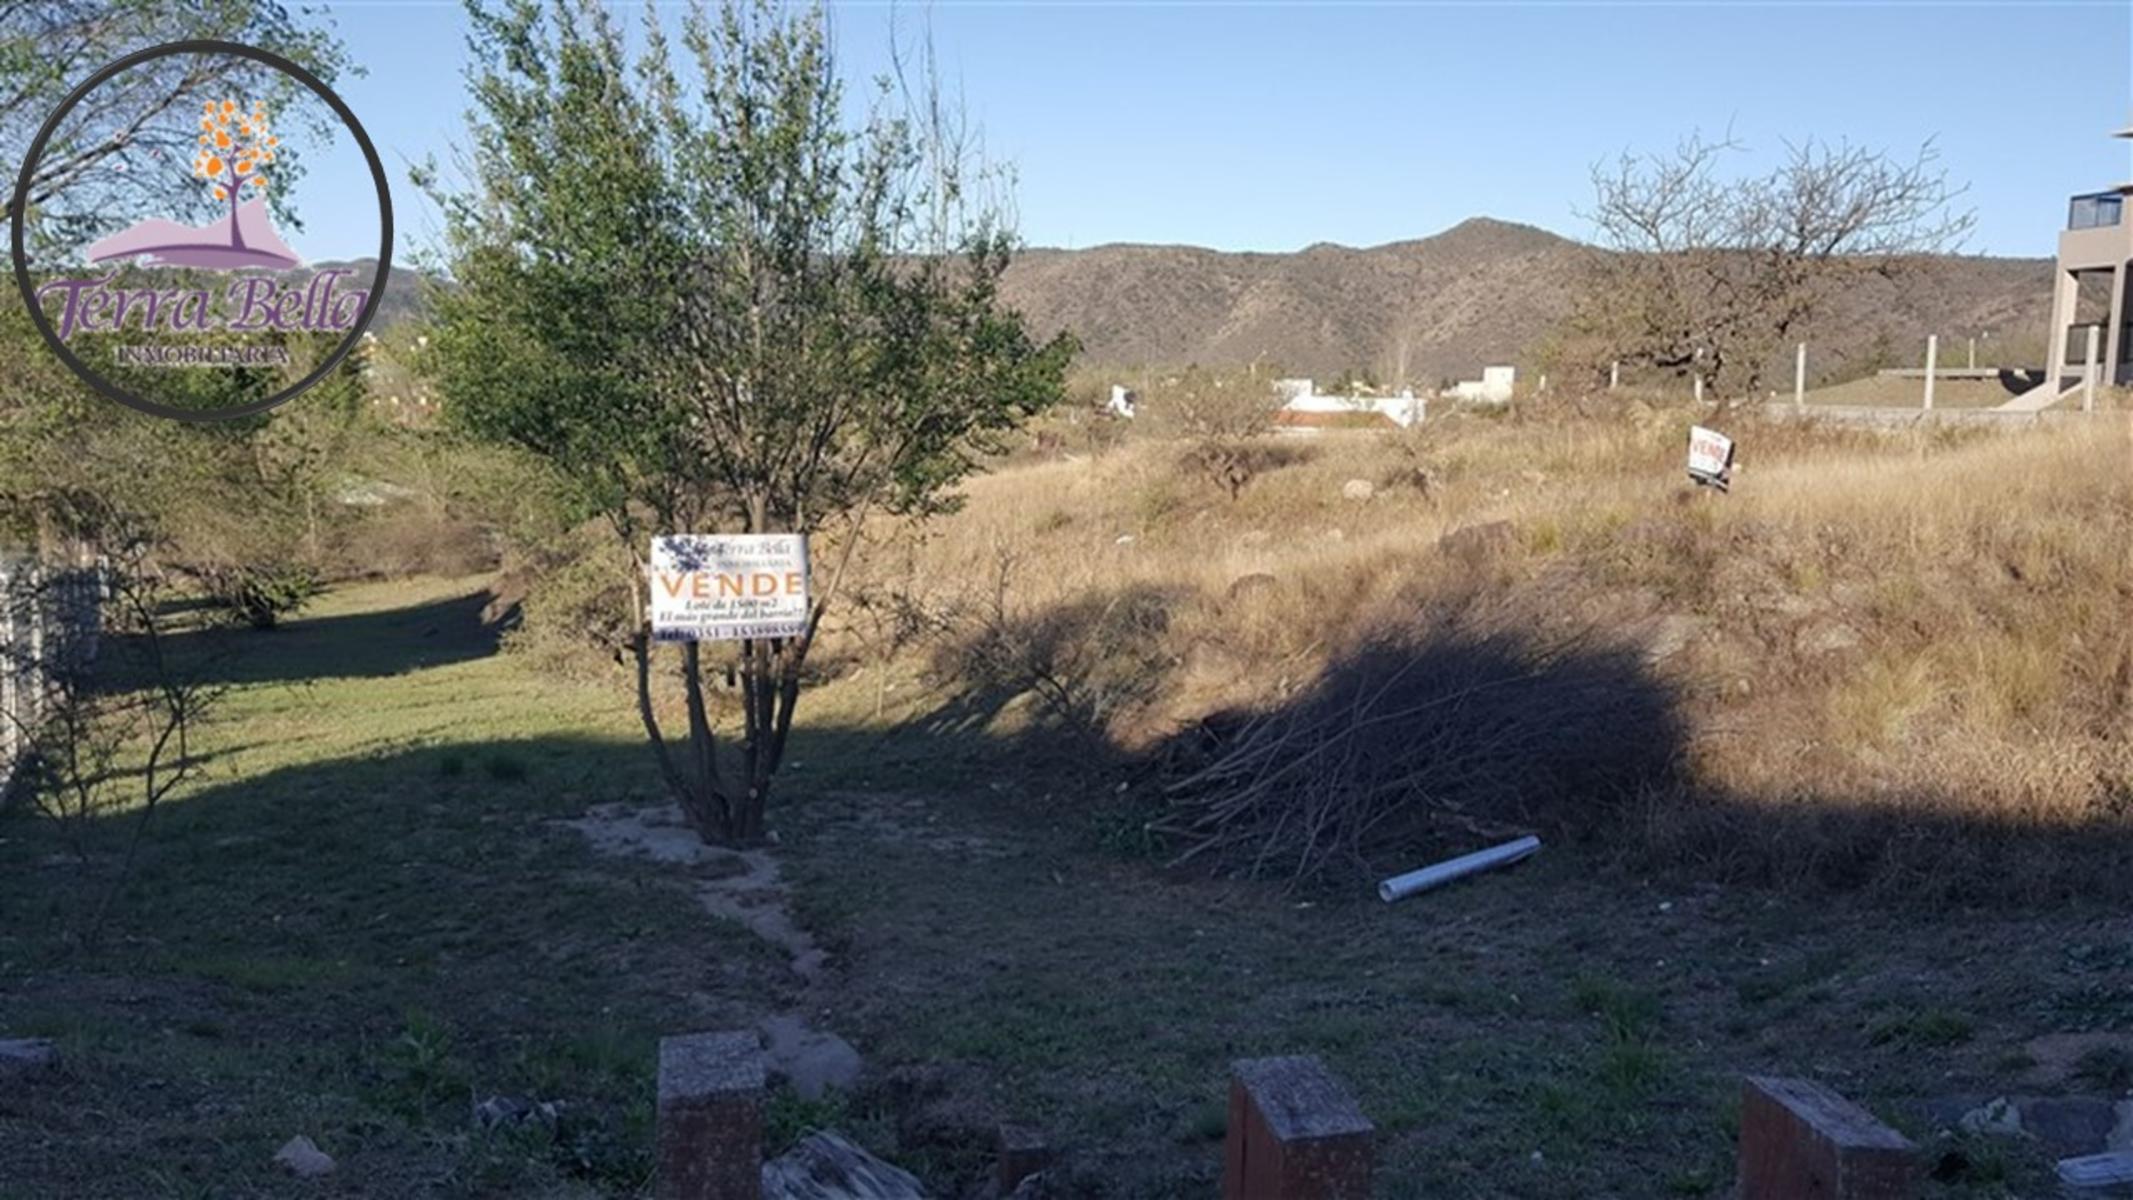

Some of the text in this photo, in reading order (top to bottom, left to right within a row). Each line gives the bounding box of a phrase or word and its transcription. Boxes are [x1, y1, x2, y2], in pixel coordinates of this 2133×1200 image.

[660, 572, 803, 598] VENDE
[713, 600, 726, 610] de
[700, 609, 739, 624] grande
[741, 608, 758, 620] del
